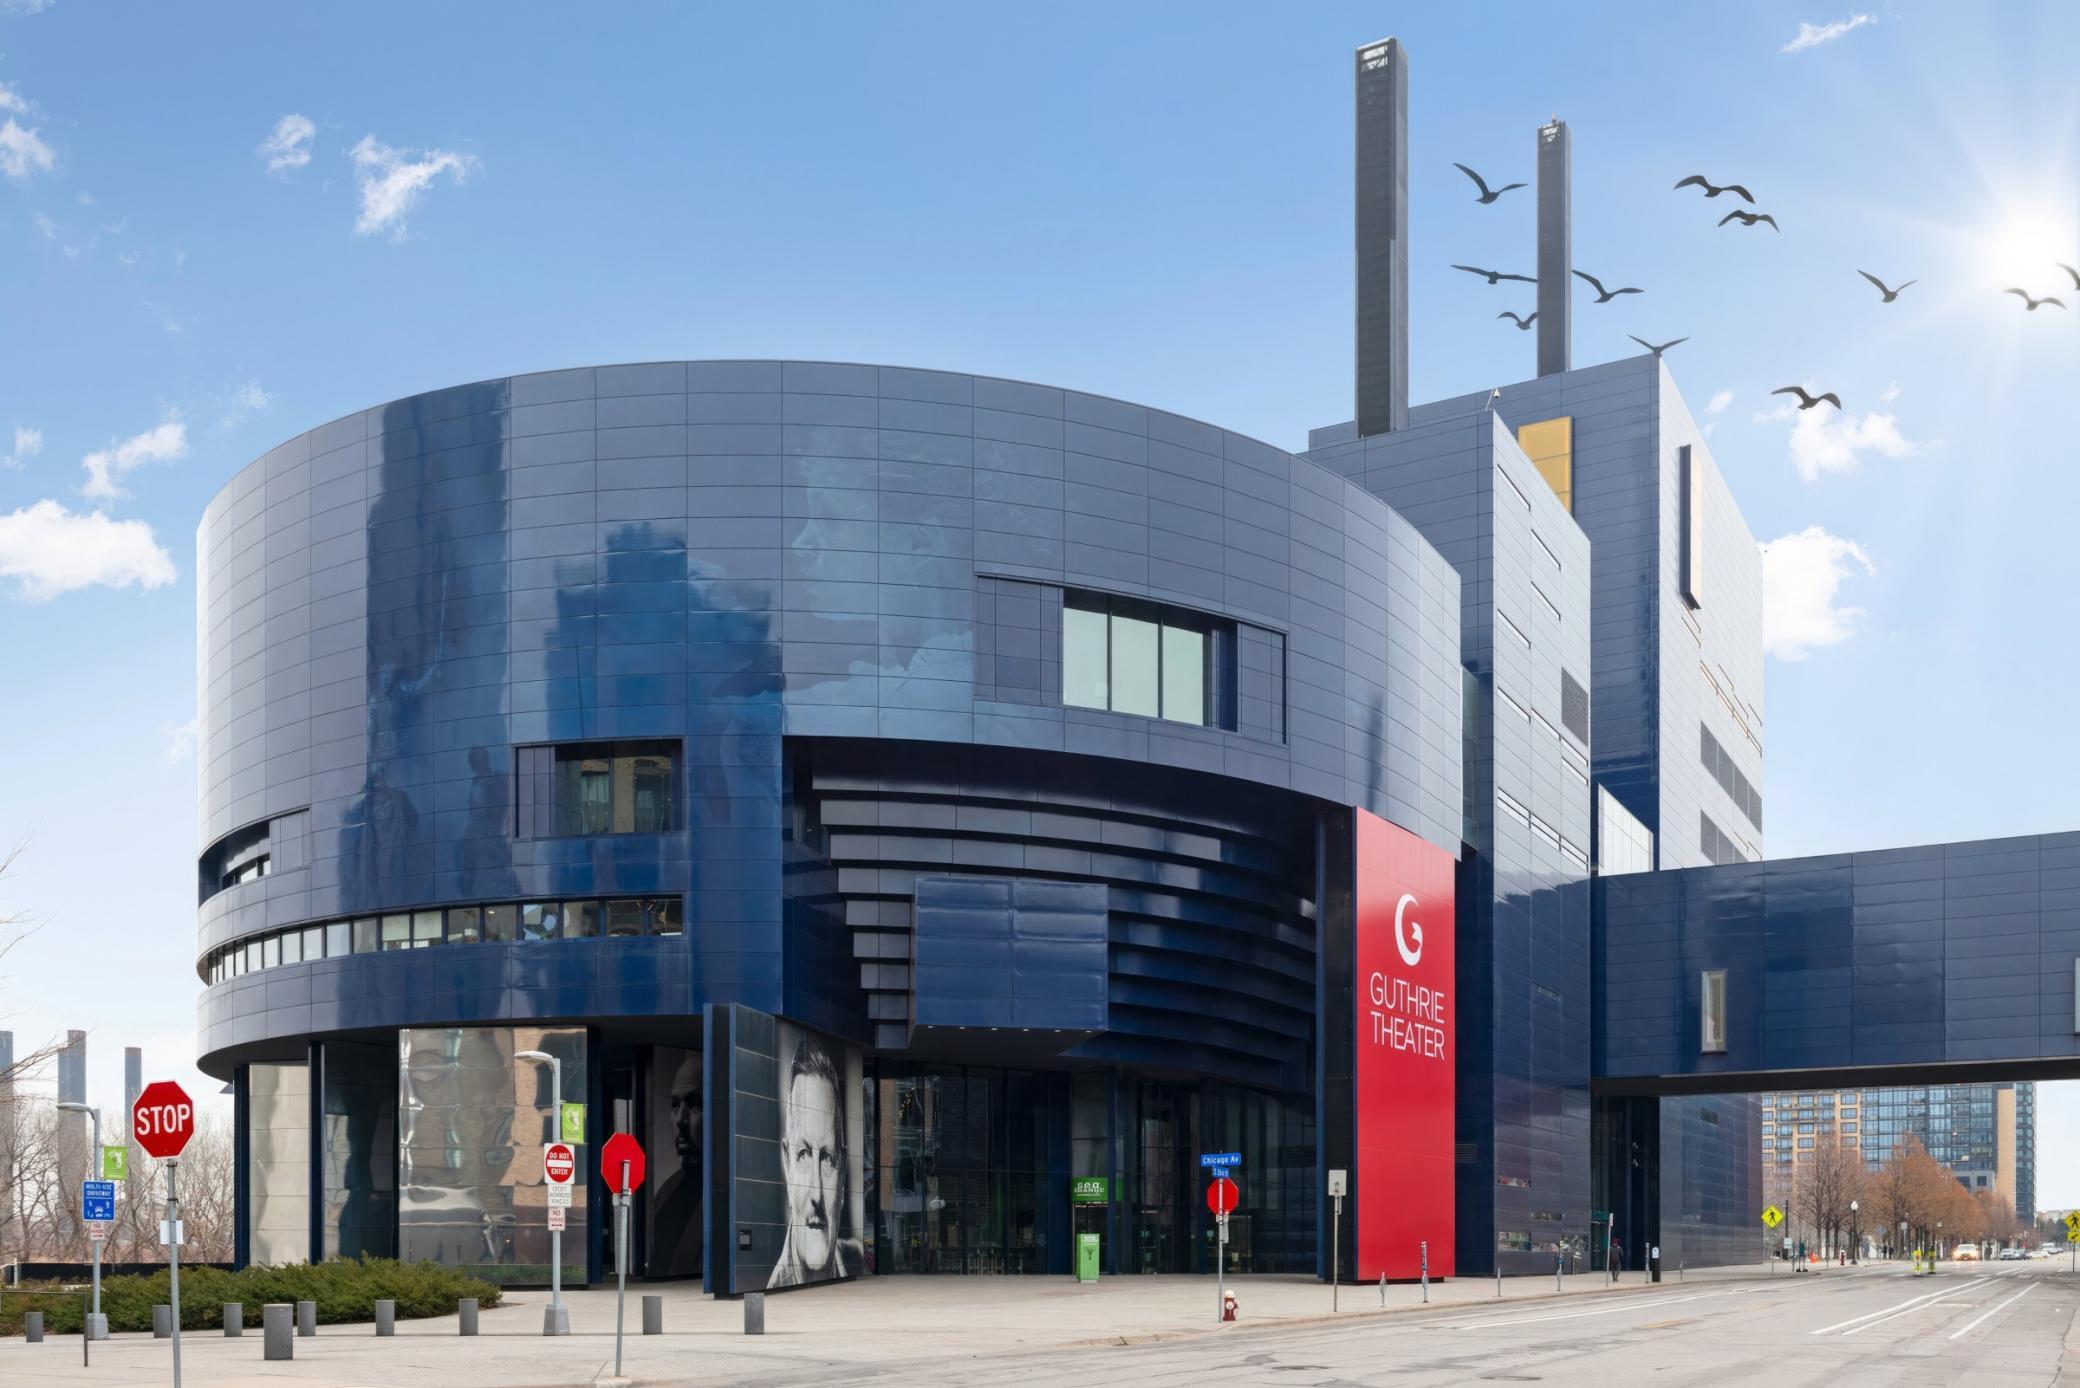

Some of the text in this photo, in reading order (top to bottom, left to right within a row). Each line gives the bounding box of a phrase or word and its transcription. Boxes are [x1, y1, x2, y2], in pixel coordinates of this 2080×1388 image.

[1370, 971, 1445, 1024] GUTHRIE
[1370, 1011, 1445, 1061] THEATER
[137, 1104, 190, 1135] STOP
[559, 1152, 570, 1160] NOT
[1203, 1156, 1229, 1166] Chicago
